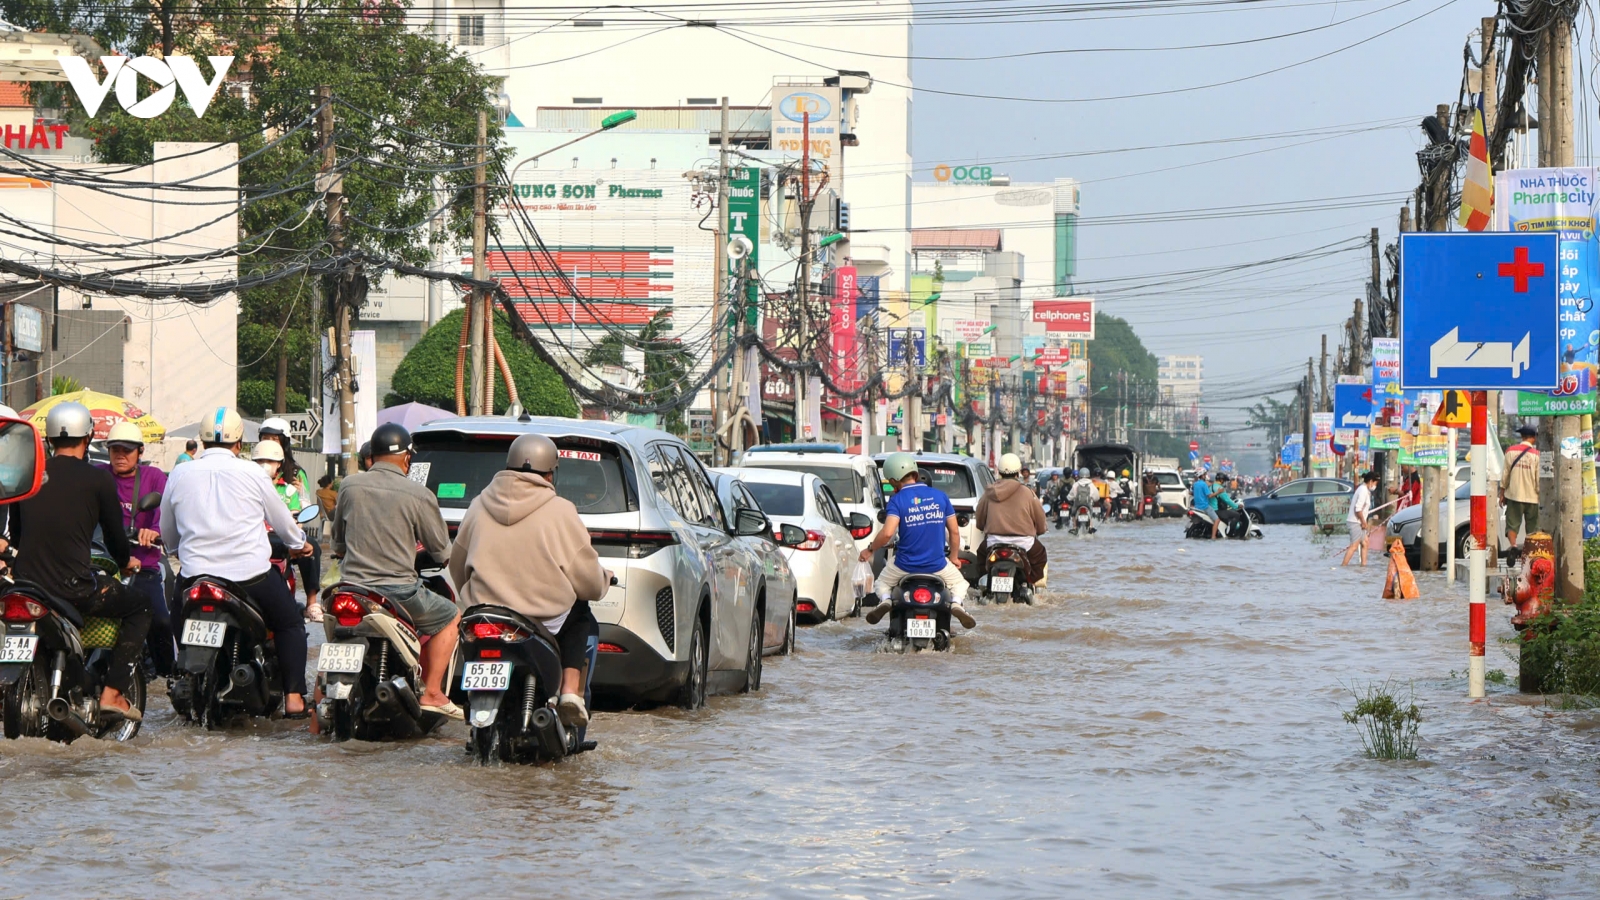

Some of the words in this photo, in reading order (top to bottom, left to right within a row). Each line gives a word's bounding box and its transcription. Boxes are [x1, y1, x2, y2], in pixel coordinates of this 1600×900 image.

[0, 117, 69, 149] HÁT
[953, 166, 992, 180] OCB
[1520, 176, 1545, 188] NHÀ
[1547, 174, 1587, 187] THUỐC
[512, 183, 557, 198] RUNG
[608, 184, 663, 198] Pharma
[1513, 188, 1595, 206] Pharmacity
[1531, 221, 1544, 229] TIM
[1562, 265, 1579, 278] áp
[1560, 280, 1580, 293] gày
[842, 274, 853, 329] concung
[1560, 298, 1585, 308] ung
[1034, 310, 1081, 322] cellphone
[1082, 312, 1090, 322] S
[1560, 328, 1576, 340] ợp
[1376, 359, 1399, 368] HÀNG
[1545, 401, 1568, 411] 1800
[290, 420, 308, 431] RA
[576, 451, 599, 460] TAXI
[920, 502, 940, 511] THUỐC
[905, 514, 924, 523] LONG
[925, 510, 944, 519] CHÂU
[4, 638, 30, 648] 5-AA
[187, 632, 218, 645] 0446
[327, 645, 357, 657] 65-B1
[321, 658, 359, 670] 285.59
[471, 664, 504, 675] 65-B2
[465, 676, 507, 688] 520.99
